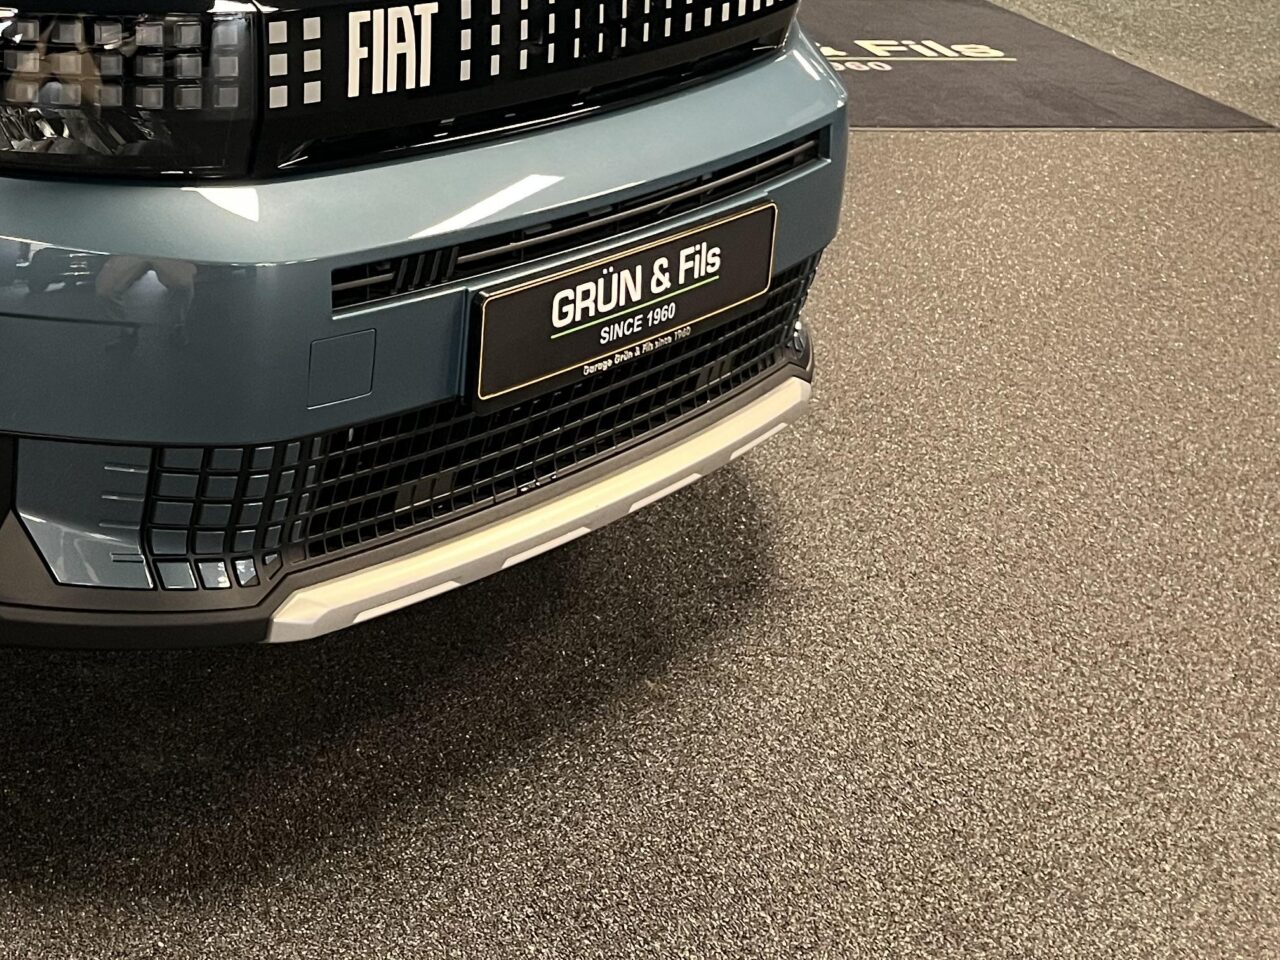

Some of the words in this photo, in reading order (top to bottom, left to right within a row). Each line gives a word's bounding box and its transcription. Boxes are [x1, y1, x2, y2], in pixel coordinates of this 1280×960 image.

[348, 2, 439, 98] FIAT
[829, 61, 893, 71] 960
[853, 39, 1005, 58] Fils
[551, 264, 643, 329] GRÜN
[650, 256, 671, 294] &
[678, 241, 721, 285] Fils
[599, 314, 644, 345] SINCE
[646, 301, 676, 328] 1960
[583, 358, 613, 376] Garage
[614, 351, 634, 364] Grün
[654, 335, 673, 349] since
[674, 326, 692, 341] 1960
